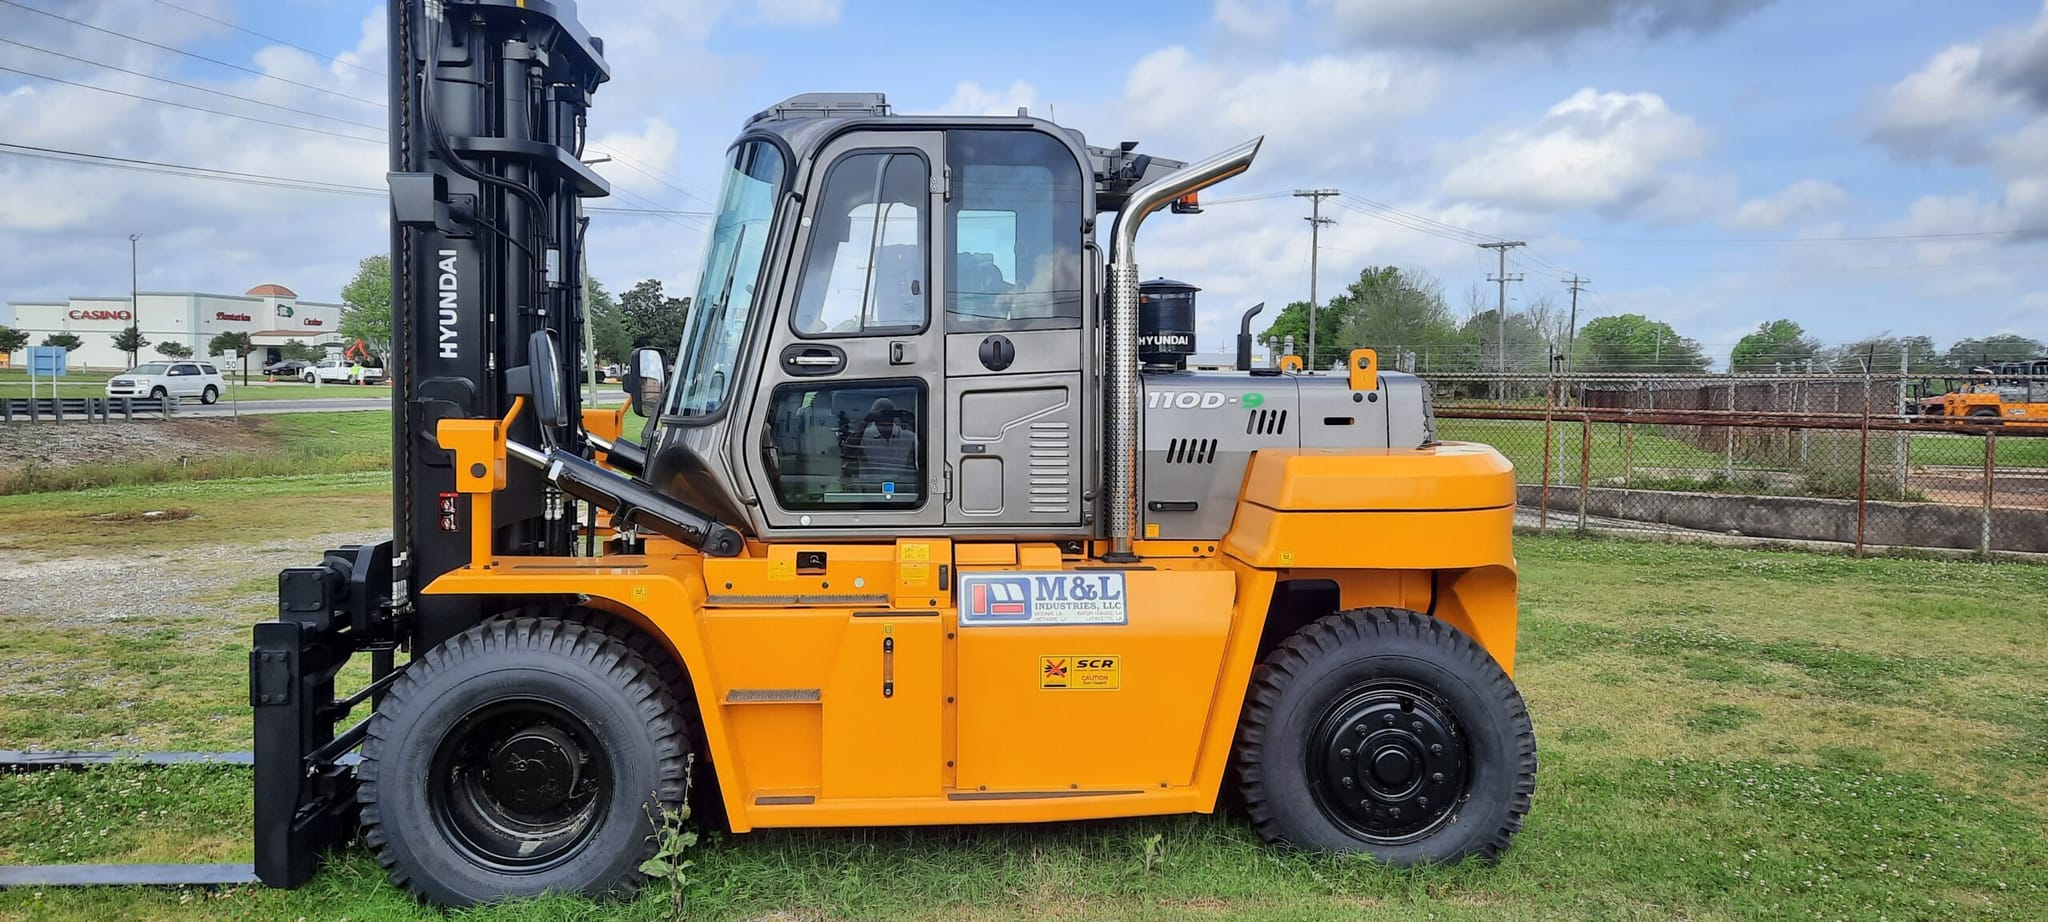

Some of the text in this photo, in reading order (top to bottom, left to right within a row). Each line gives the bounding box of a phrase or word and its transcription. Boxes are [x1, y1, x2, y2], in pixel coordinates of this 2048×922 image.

[438, 249, 458, 358] HYUNDAI
[68, 309, 131, 320] CASINO
[1138, 335, 1189, 346] HYUNDAI
[225, 360, 236, 369] 50
[1148, 391, 1265, 409] 110D-9
[1034, 575, 1121, 601] M&L
[1034, 601, 1122, 611] INDUSTRIES, LLC
[1076, 659, 1114, 668] SCR
